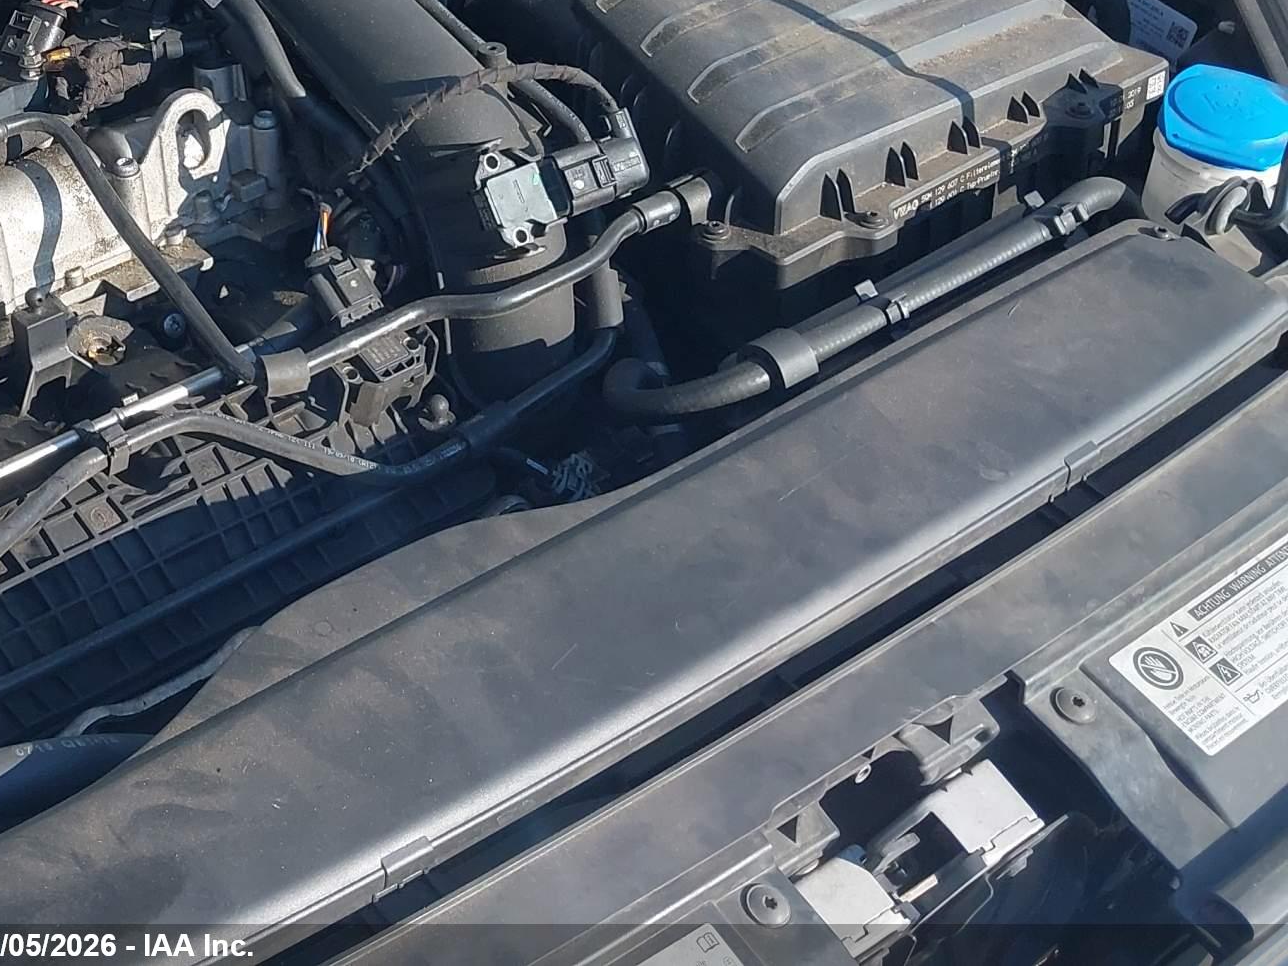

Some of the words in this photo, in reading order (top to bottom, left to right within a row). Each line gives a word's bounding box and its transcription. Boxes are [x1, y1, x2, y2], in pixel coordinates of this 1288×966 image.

[935, 185, 945, 196] 129
[960, 175, 965, 183] C
[1193, 588, 1231, 619] ACHTUNG
[1228, 564, 1266, 592] WARNING
